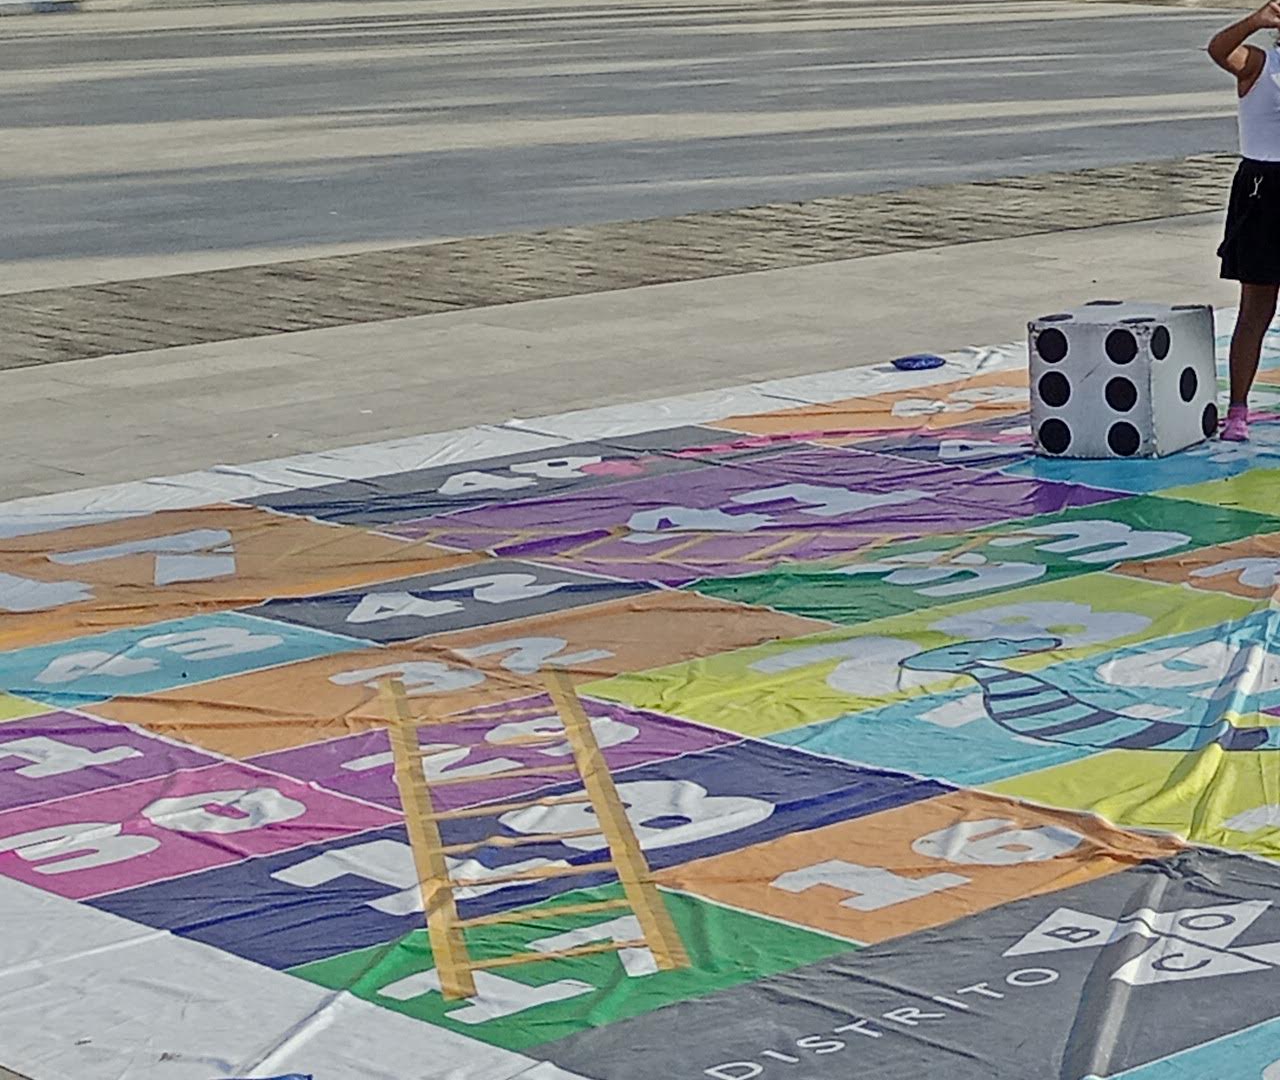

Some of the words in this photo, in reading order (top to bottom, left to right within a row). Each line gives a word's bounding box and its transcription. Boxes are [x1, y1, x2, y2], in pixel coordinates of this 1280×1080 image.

[437, 455, 602, 496] 48
[620, 483, 935, 545] 41
[837, 520, 1192, 598] 33
[346, 573, 573, 624] 42
[35, 627, 285, 685] 43
[329, 636, 616, 696] 32
[747, 601, 1154, 698] 28
[340, 716, 642, 787] 29
[0, 787, 307, 877] 30
[270, 780, 776, 918] 18
[769, 818, 1085, 913] 16
[377, 915, 661, 1025] 17
[703, 966, 1060, 1080] DISTRITO
